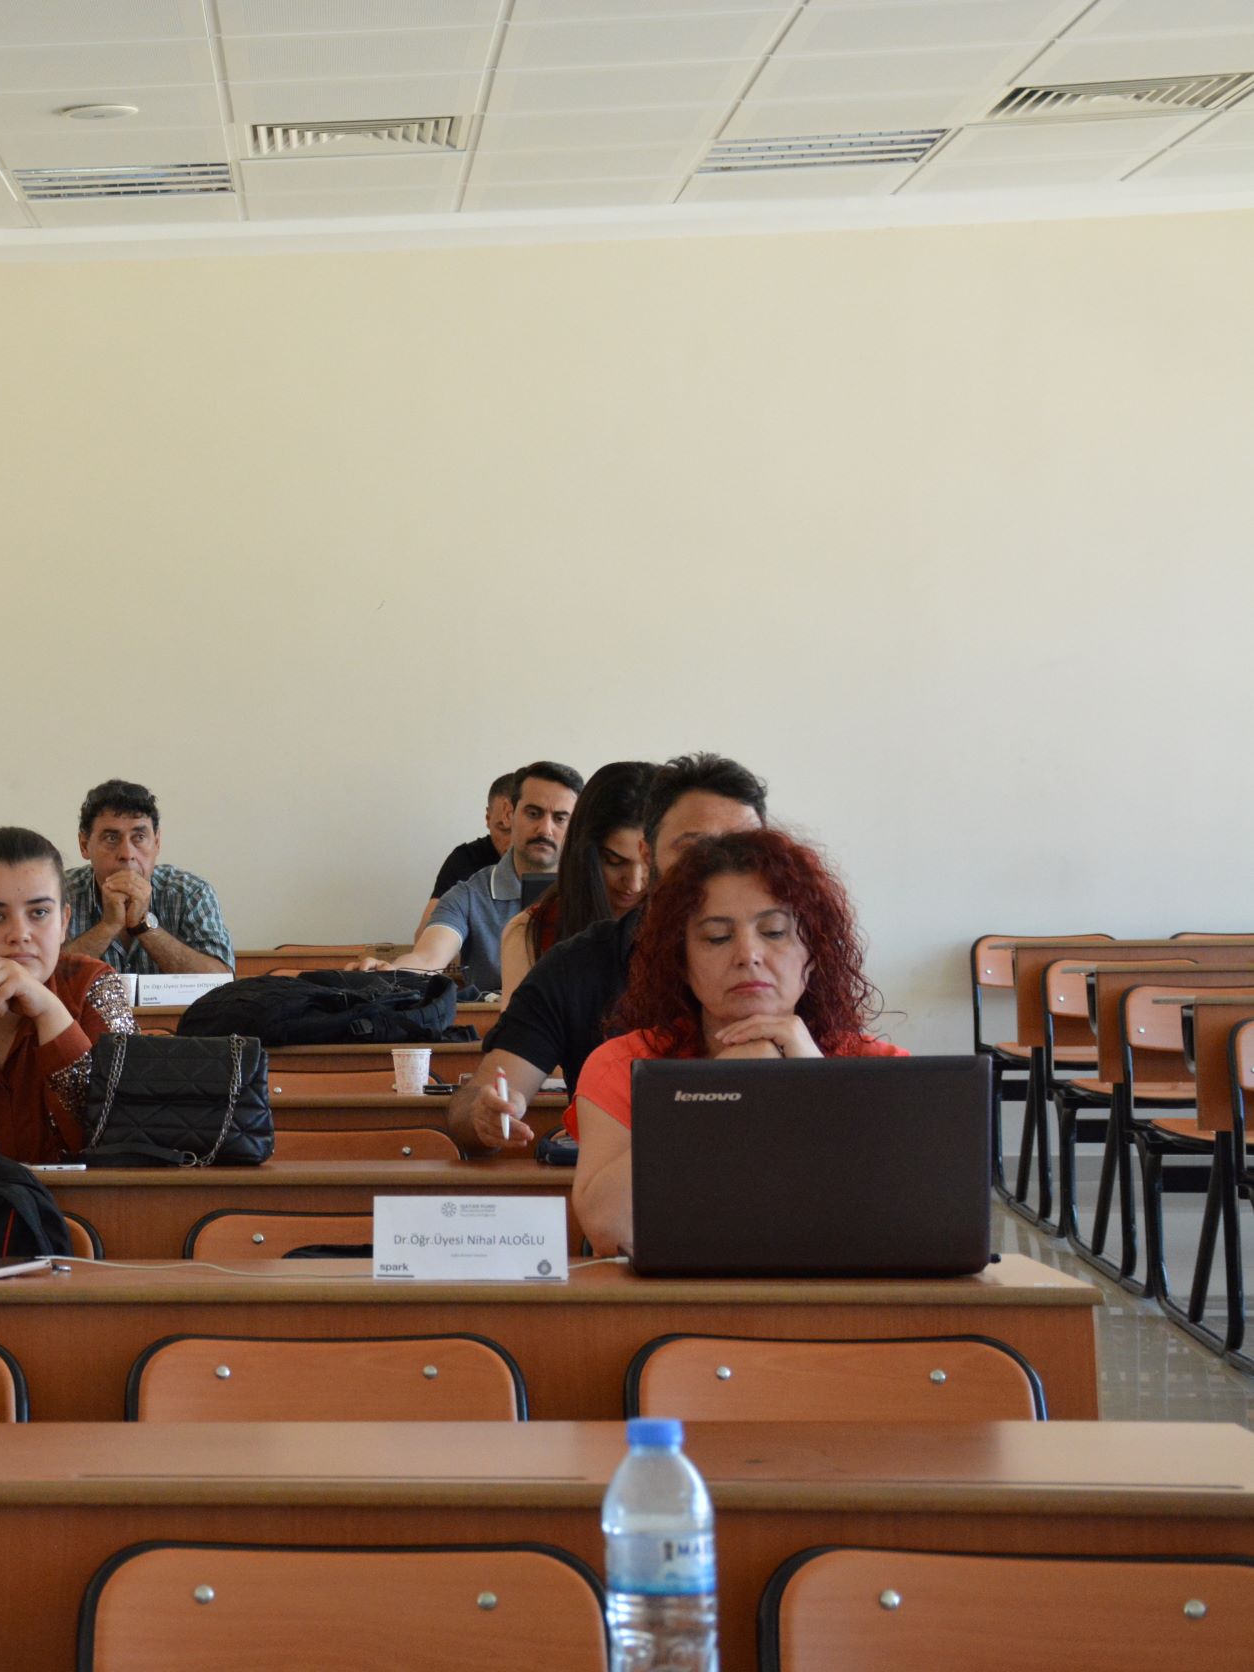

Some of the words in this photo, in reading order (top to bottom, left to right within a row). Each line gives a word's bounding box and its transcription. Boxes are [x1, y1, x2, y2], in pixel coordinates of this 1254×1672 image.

[674, 1090, 742, 1102] lenovo
[467, 1234, 496, 1246] Nihal
[499, 1232, 545, 1246] ALOĞLU
[379, 1263, 409, 1273] spark
